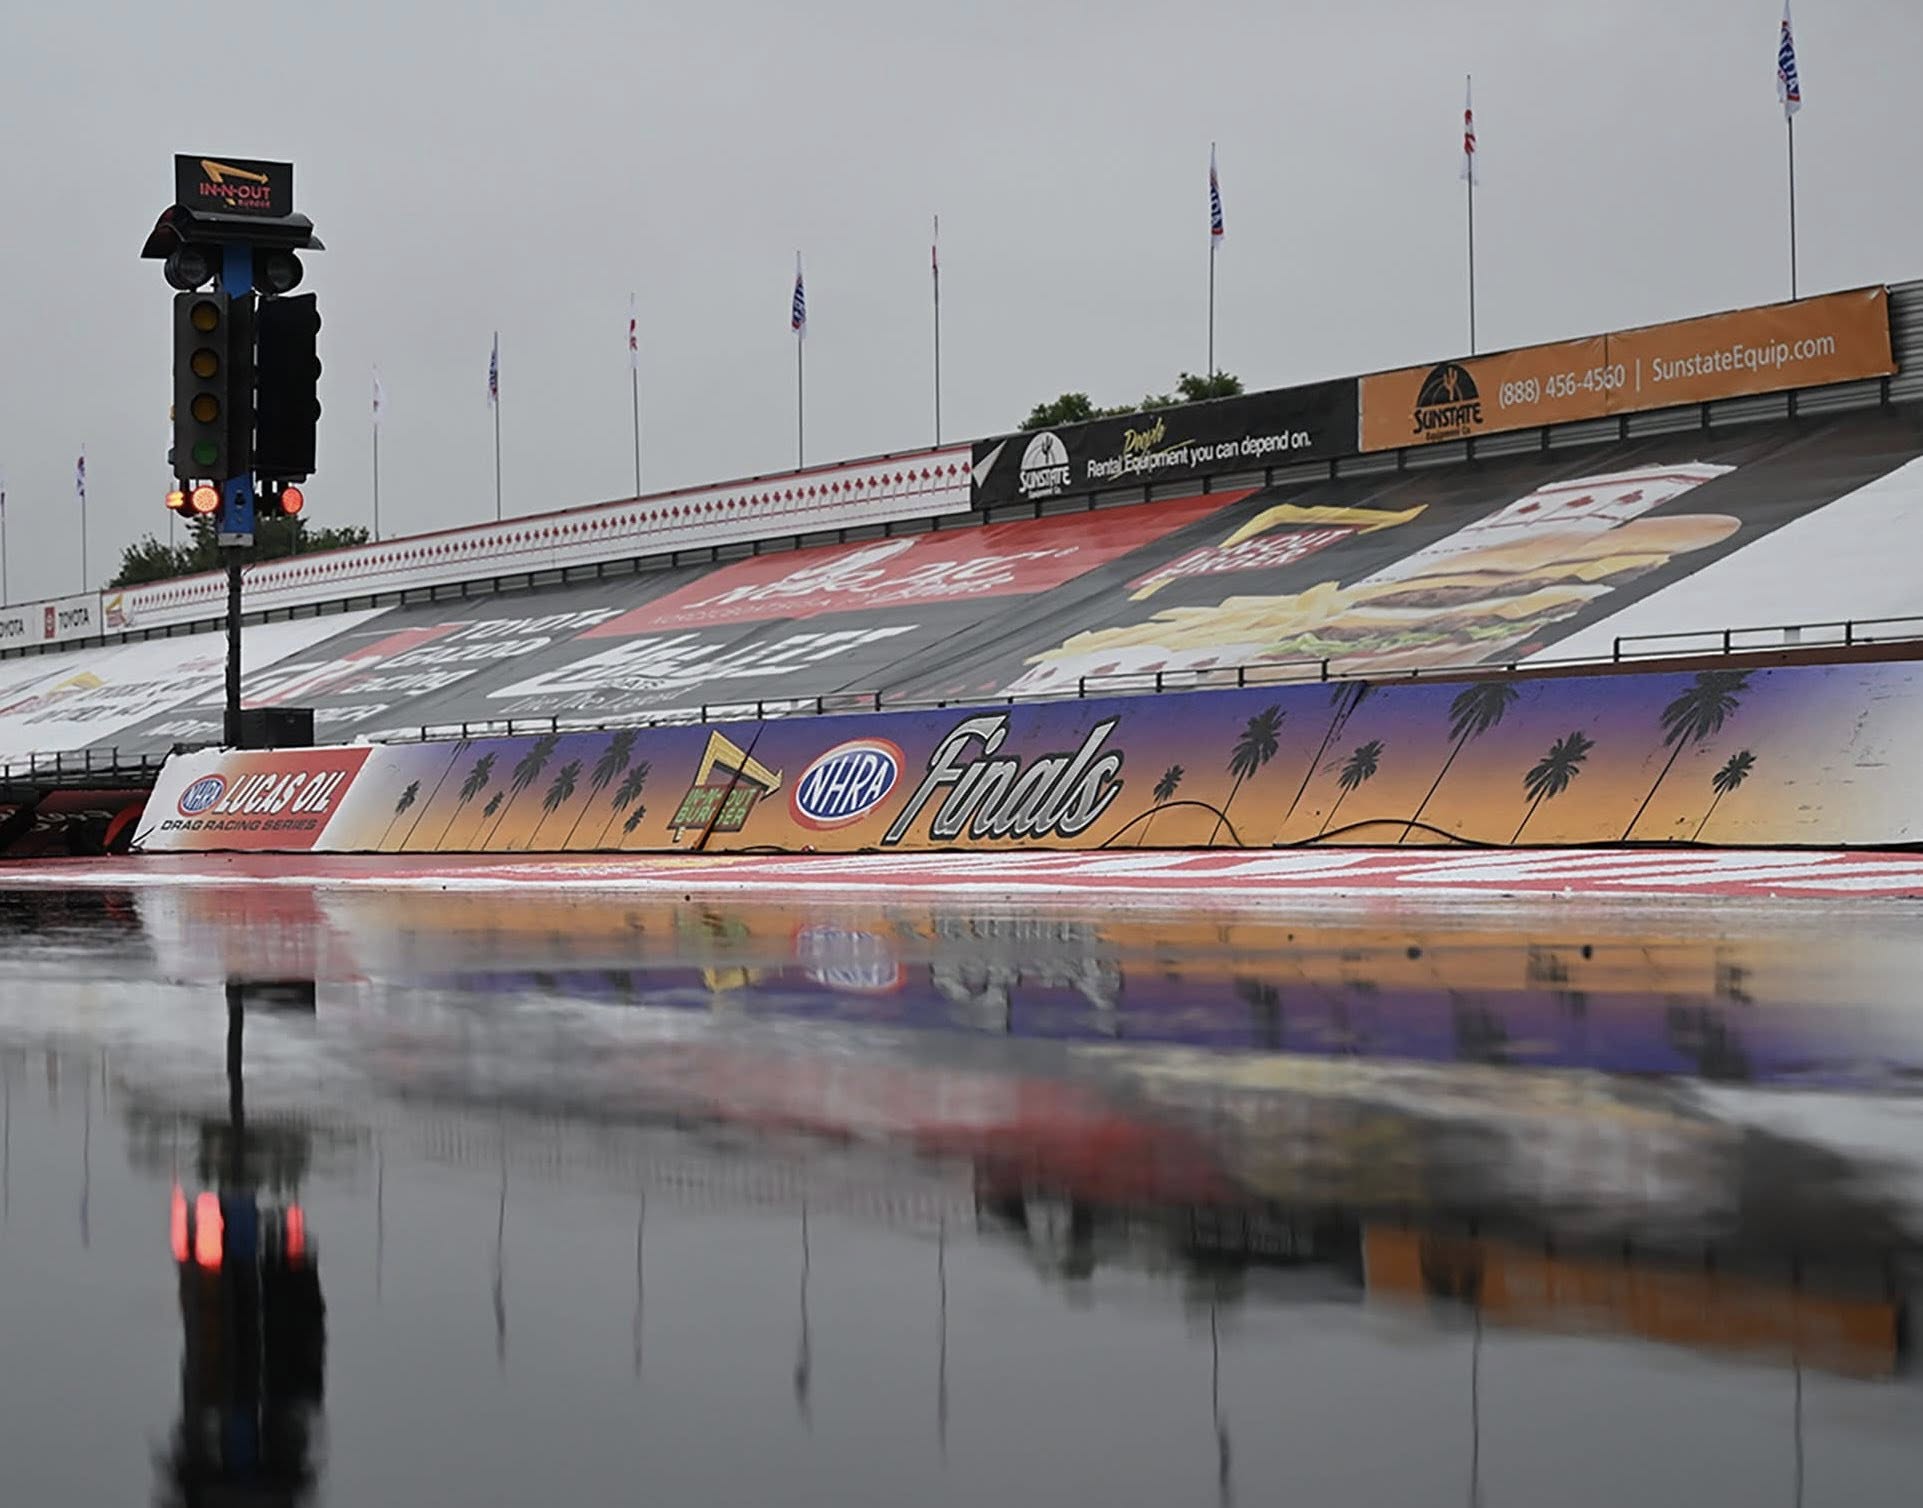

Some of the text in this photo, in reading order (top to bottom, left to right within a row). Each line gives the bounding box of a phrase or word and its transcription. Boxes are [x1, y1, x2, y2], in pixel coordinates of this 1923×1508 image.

[200, 182, 271, 199] IN-N-OUT
[1499, 335, 1836, 409] (888) 456-4560 SunstateEquip.com
[1413, 402, 1484, 435] SUNSTATE
[1087, 430, 1312, 479] Rental Equipment you can depend on.
[1018, 465, 1072, 494] SUNSTATE
[0, 618, 25, 638] OYOTA
[58, 607, 91, 631] TOYOTA
[212, 769, 348, 816] LUCAS OIL
[802, 752, 889, 814] NHRA
[880, 710, 1125, 846] Finals
[160, 818, 318, 832] DRAG RACING SERIES
